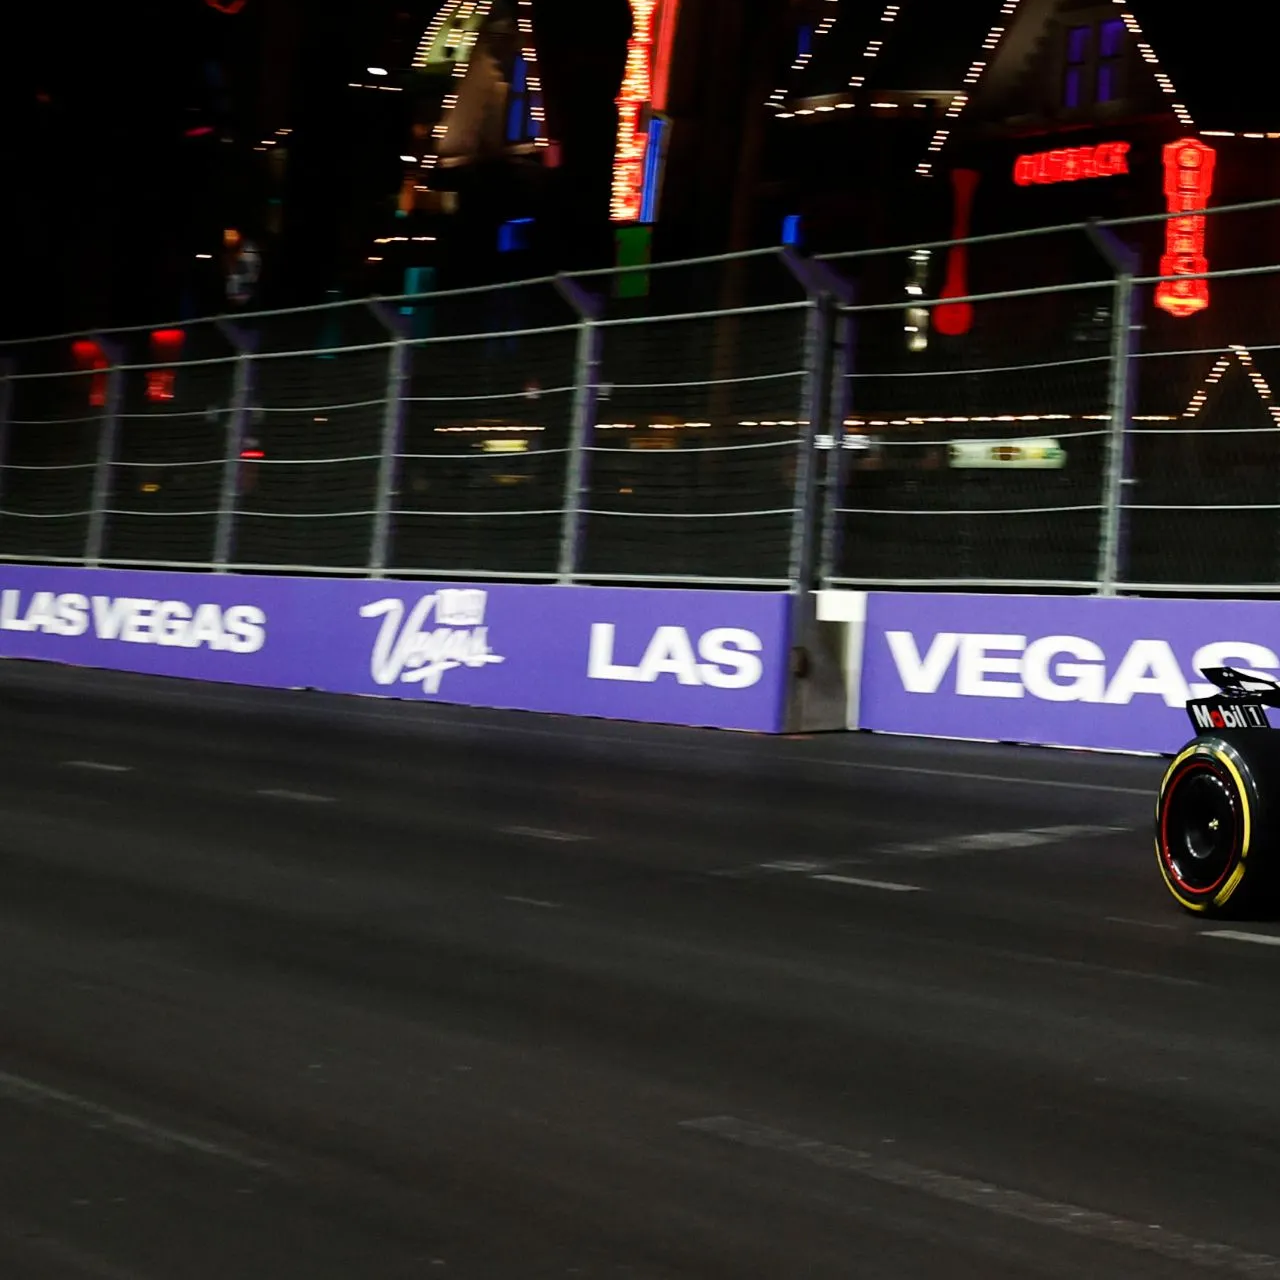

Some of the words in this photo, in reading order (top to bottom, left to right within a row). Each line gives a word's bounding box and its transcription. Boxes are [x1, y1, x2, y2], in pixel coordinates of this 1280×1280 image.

[1, 588, 90, 637] LAS
[92, 594, 267, 655] VEGAS
[588, 622, 763, 690] LAS
[885, 630, 1280, 710] VEGAS
[1192, 704, 1247, 729] Mobil
